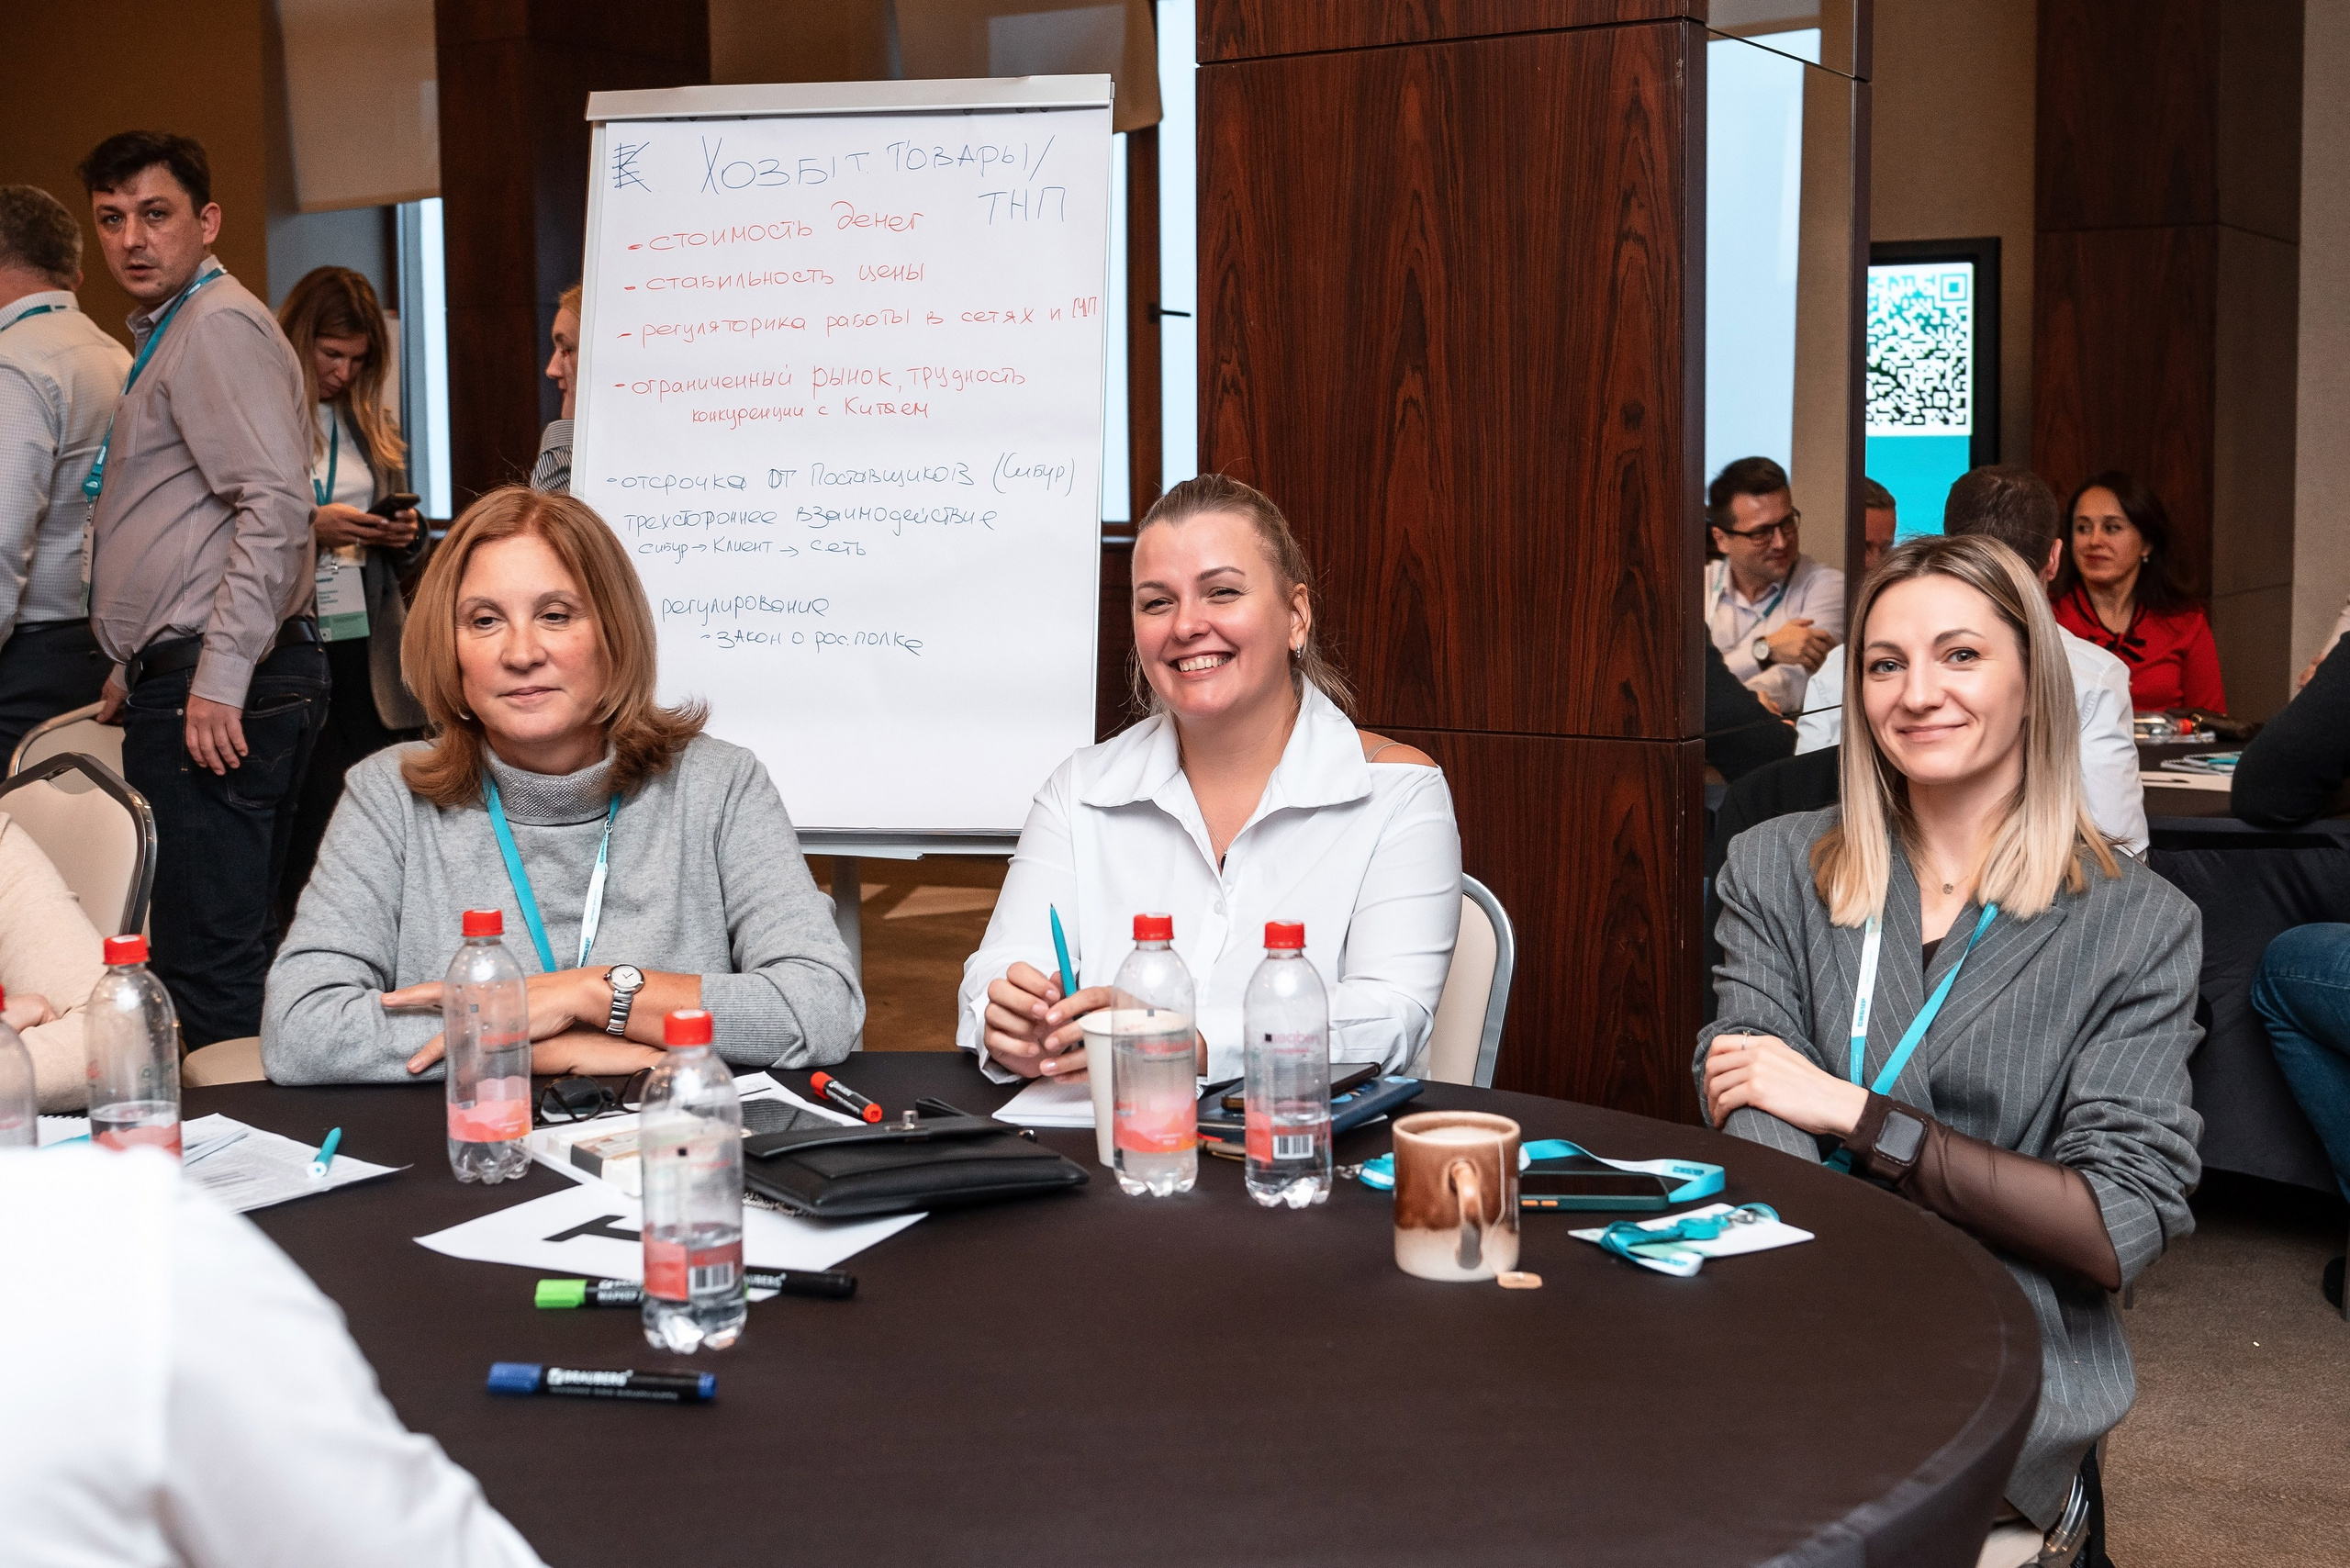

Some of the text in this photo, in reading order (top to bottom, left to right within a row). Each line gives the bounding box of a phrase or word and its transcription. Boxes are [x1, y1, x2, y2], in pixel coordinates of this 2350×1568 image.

[830, 200, 924, 232] денег
[977, 186, 1067, 226] ТНП
[858, 263, 924, 283] цены
[826, 308, 910, 338] работы
[926, 310, 945, 326] в
[960, 307, 1035, 325] сетях
[1050, 308, 1061, 321] и
[906, 366, 1025, 392] трудность
[692, 396, 929, 431] конкуренции с Китаем
[623, 505, 998, 538] трехстороннее взаимодействие
[713, 535, 774, 554] Клиент
[662, 594, 830, 627] регулирование
[1857, 997, 1867, 1027] СИБУР
